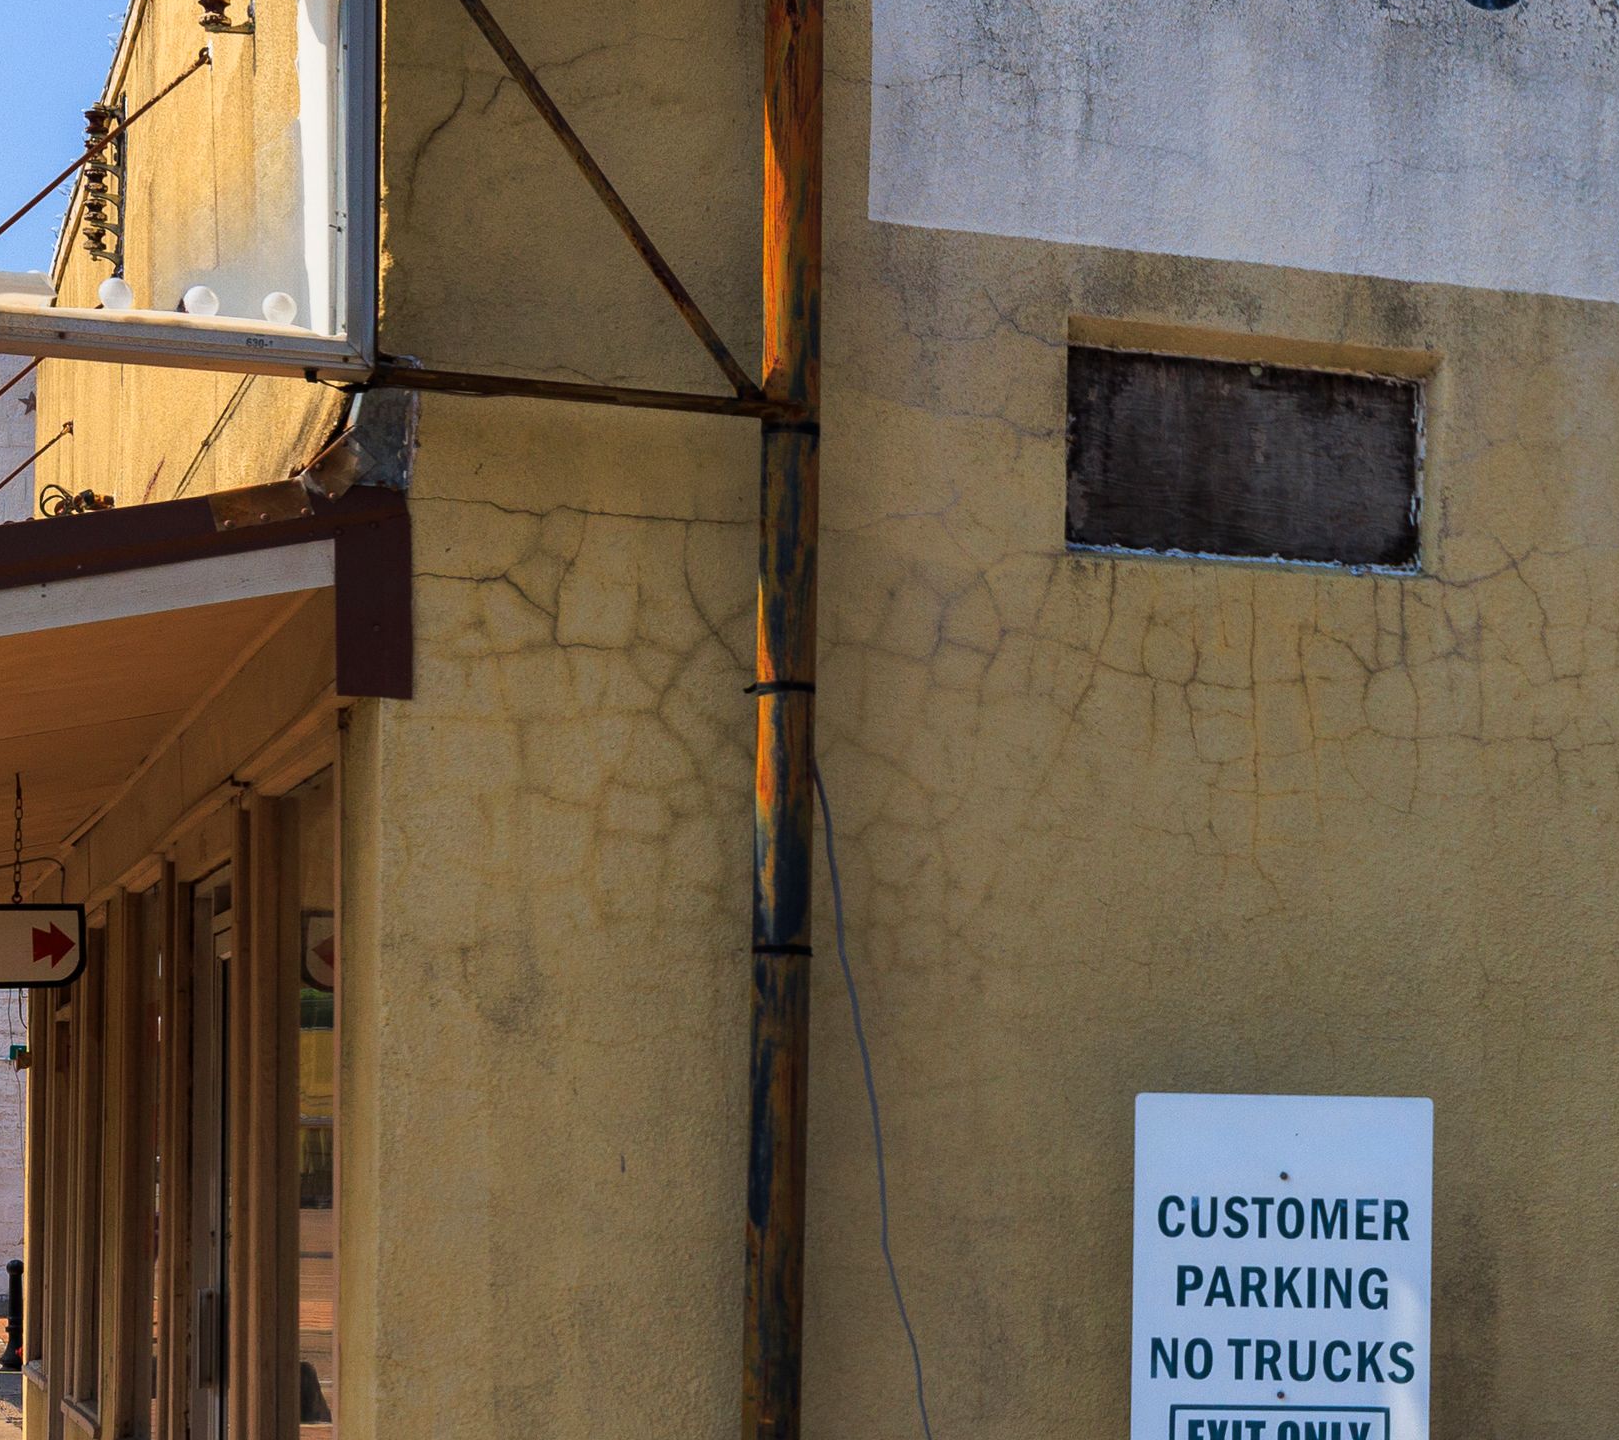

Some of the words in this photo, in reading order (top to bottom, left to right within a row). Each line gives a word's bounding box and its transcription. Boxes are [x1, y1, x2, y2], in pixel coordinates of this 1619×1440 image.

[1157, 1194, 1410, 1241] CUSTOMER
[1176, 1264, 1389, 1311] PARKING
[1150, 1336, 1214, 1380] NO
[1227, 1338, 1415, 1384] TRUCKS
